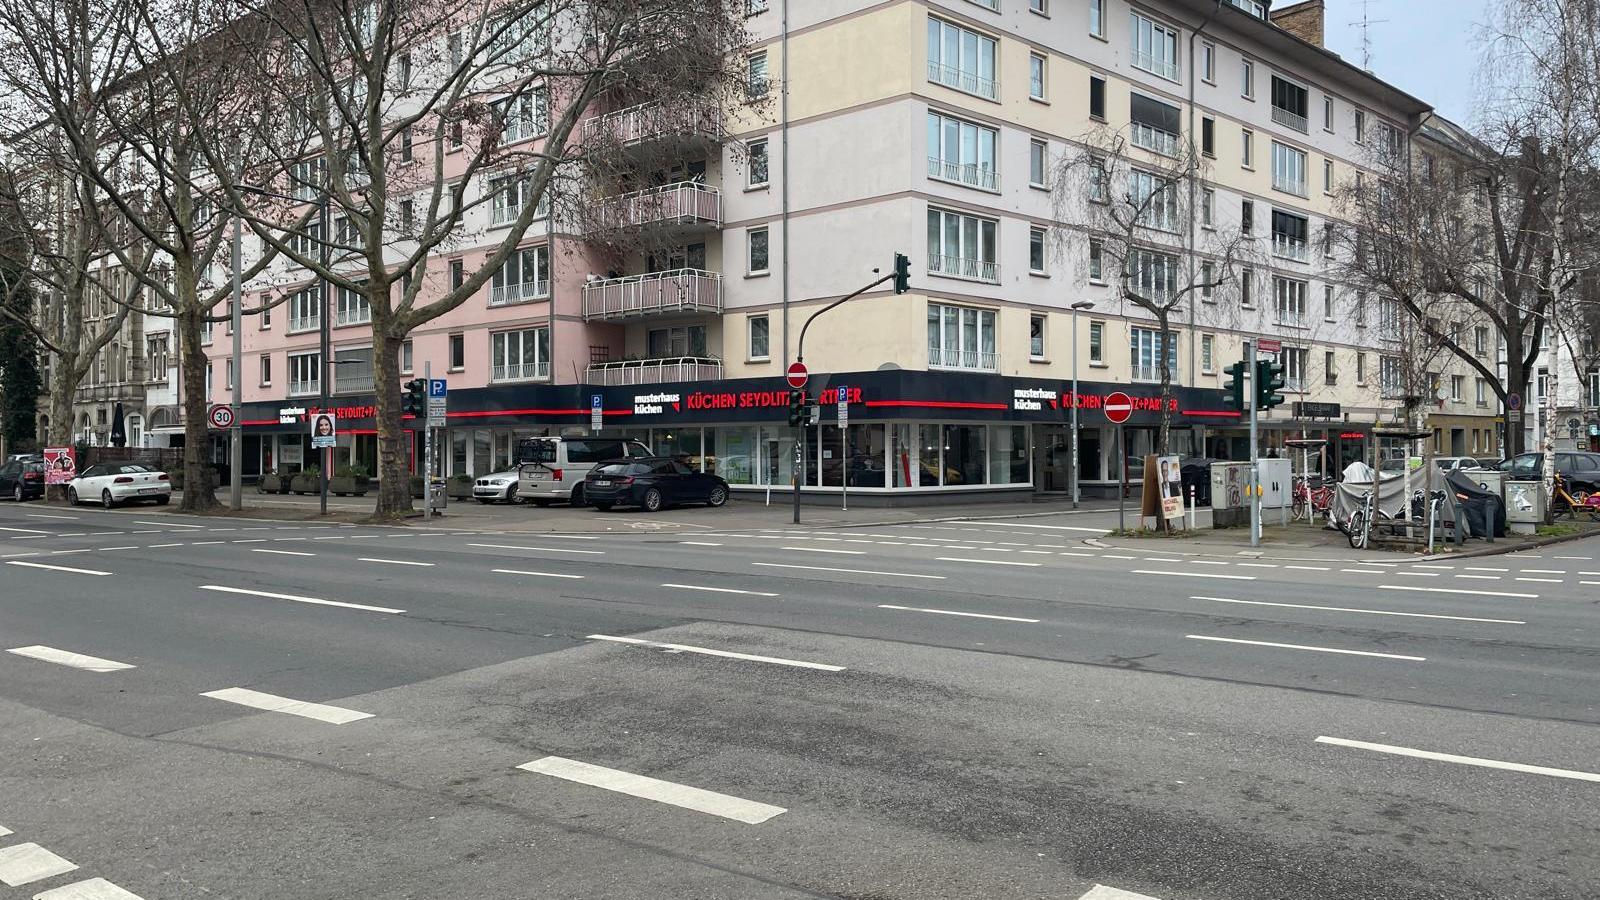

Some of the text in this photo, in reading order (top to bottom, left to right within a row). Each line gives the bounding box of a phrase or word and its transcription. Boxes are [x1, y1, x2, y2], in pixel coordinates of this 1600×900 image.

[432, 381, 443, 395] P
[1014, 388, 1057, 399] musterhaus
[634, 393, 680, 404] musterhaus
[687, 391, 736, 409] KÜCHEN
[1014, 398, 1042, 410] küchen
[634, 403, 663, 415] küchen
[215, 411, 230, 423] 30
